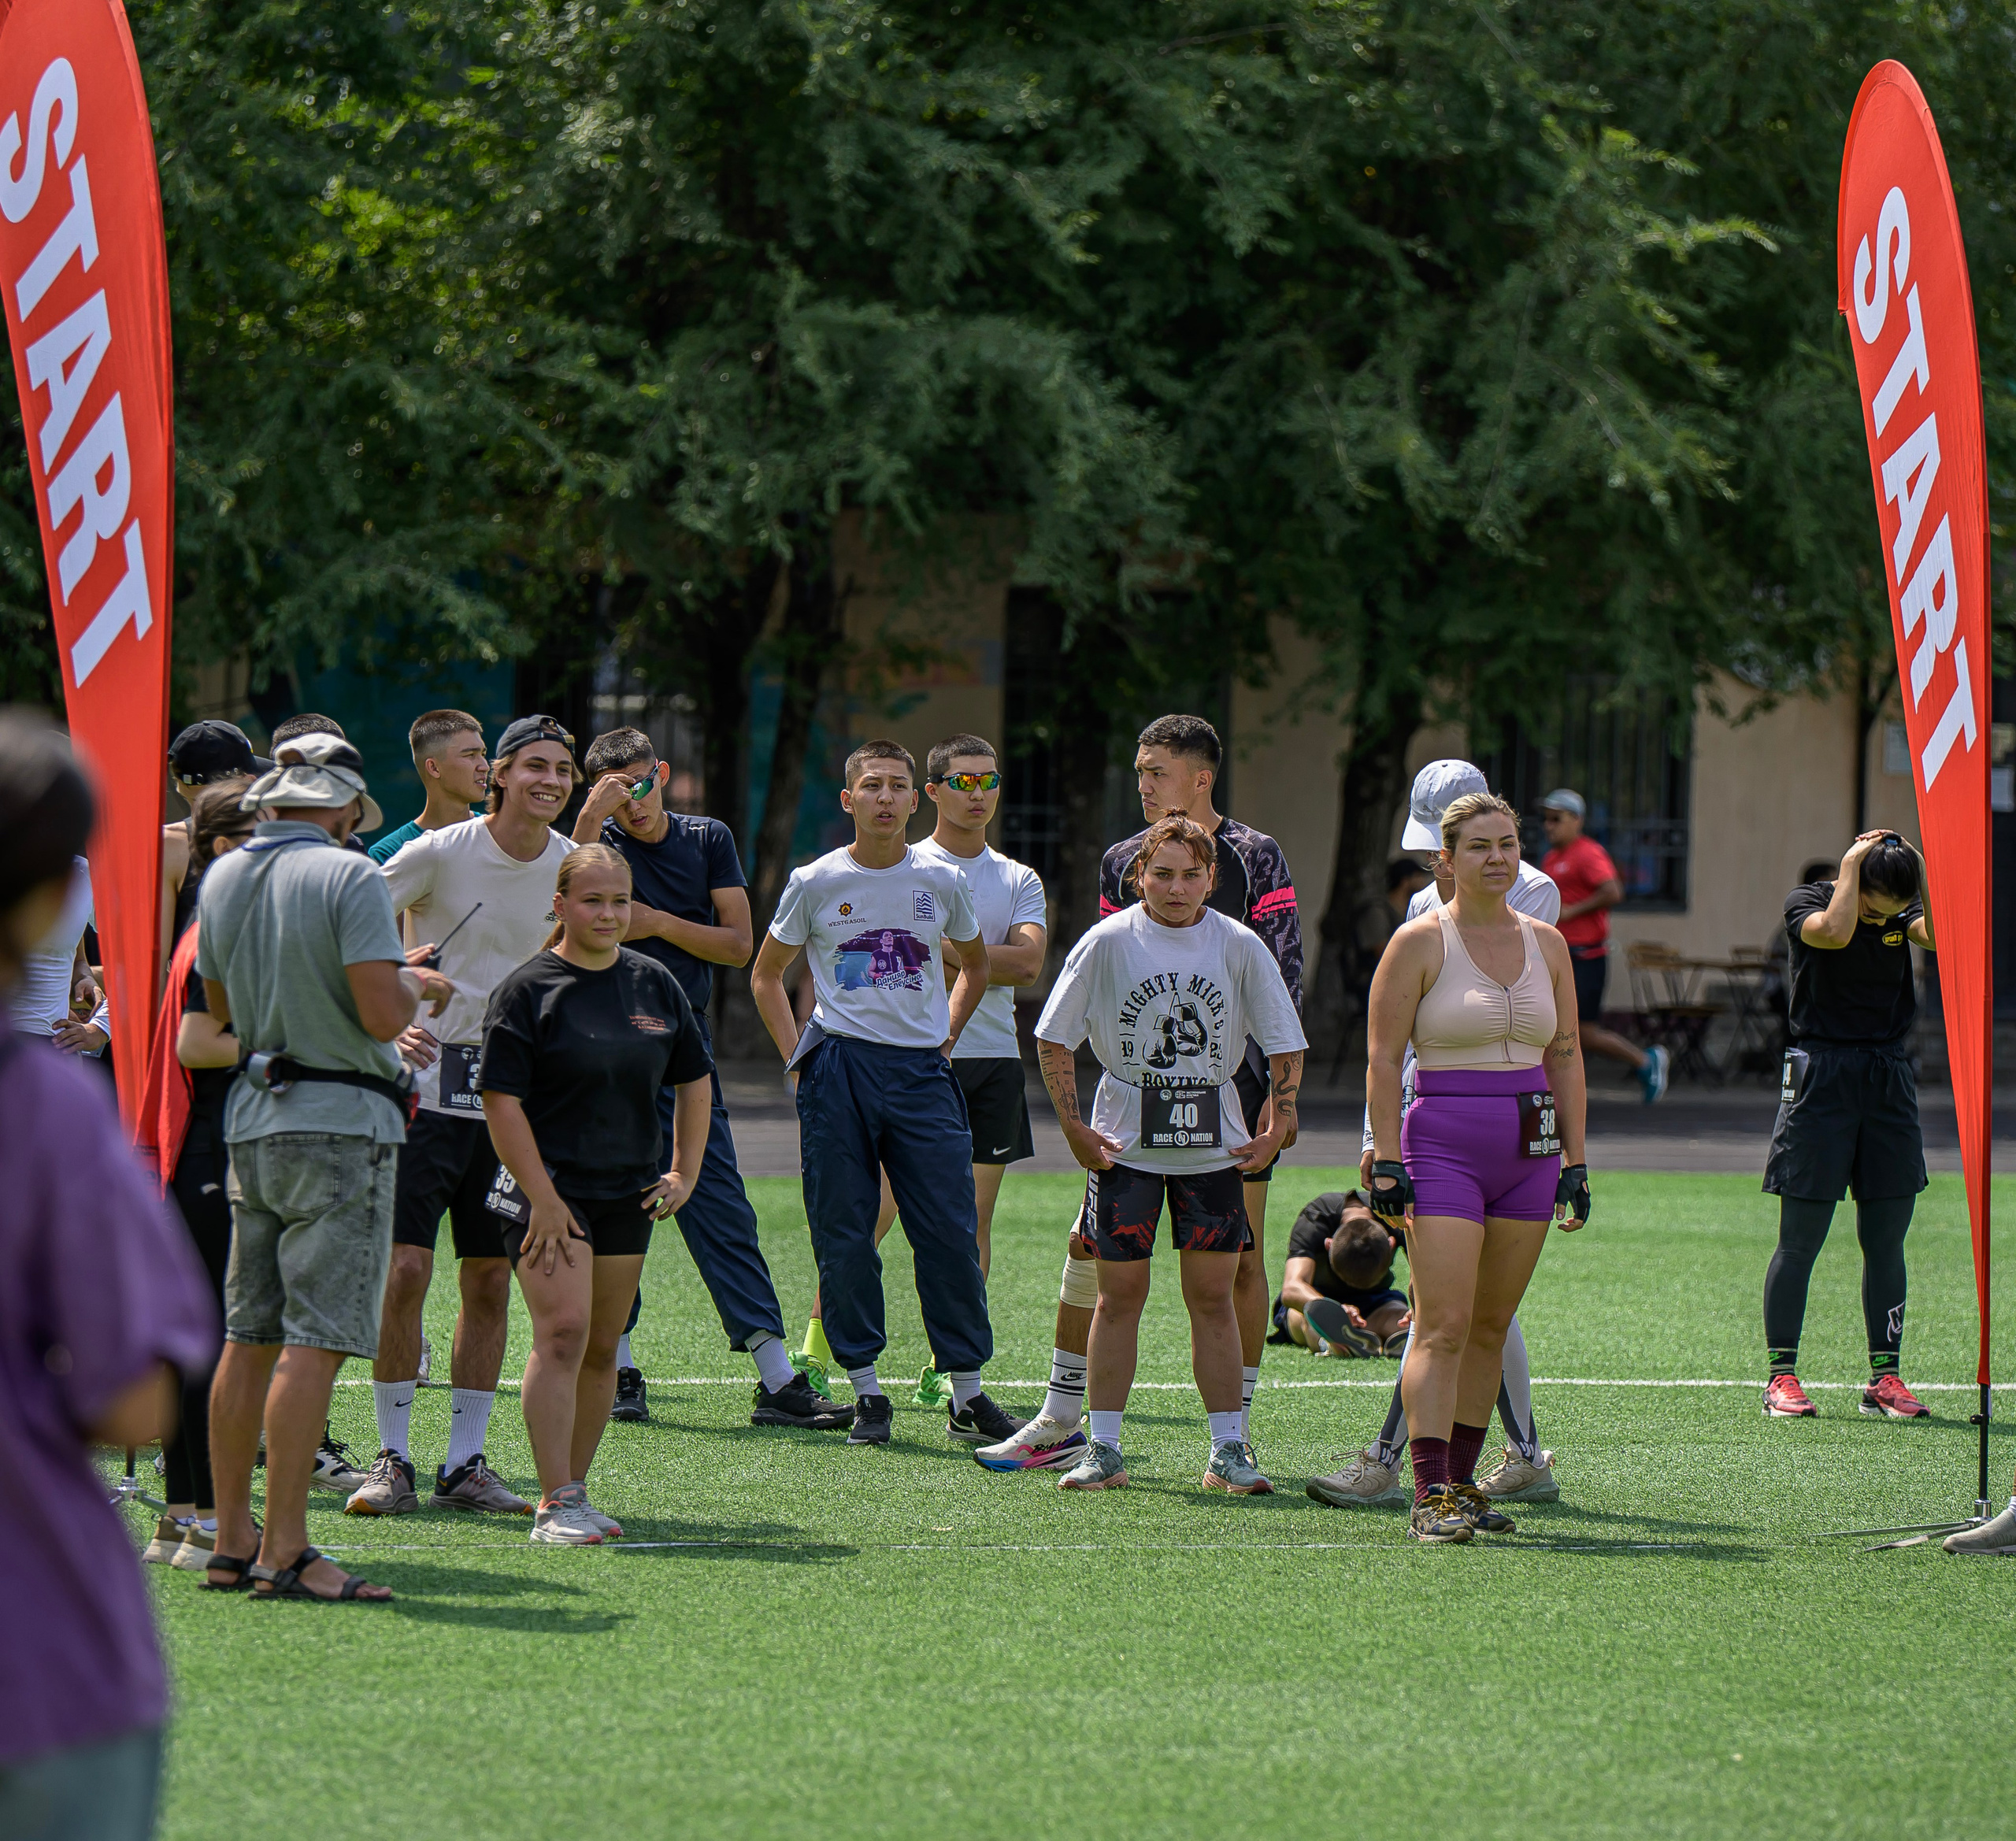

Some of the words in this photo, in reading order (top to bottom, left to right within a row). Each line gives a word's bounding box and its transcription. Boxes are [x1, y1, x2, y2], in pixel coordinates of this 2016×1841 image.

[0, 57, 153, 688] START
[1852, 186, 1978, 793] START
[828, 917, 867, 928] WESTGASOIL
[876, 969, 906, 989] Данияр
[1119, 972, 1180, 1028] MIGHTY
[1121, 1039, 1134, 1058] 19
[1169, 1103, 1199, 1128] 40
[1540, 1109, 1555, 1135] 38
[1153, 1133, 1173, 1143] RACE
[1191, 1132, 1214, 1143] NATION
[1529, 1141, 1542, 1151] RACE
[499, 1198, 522, 1214] NATION
